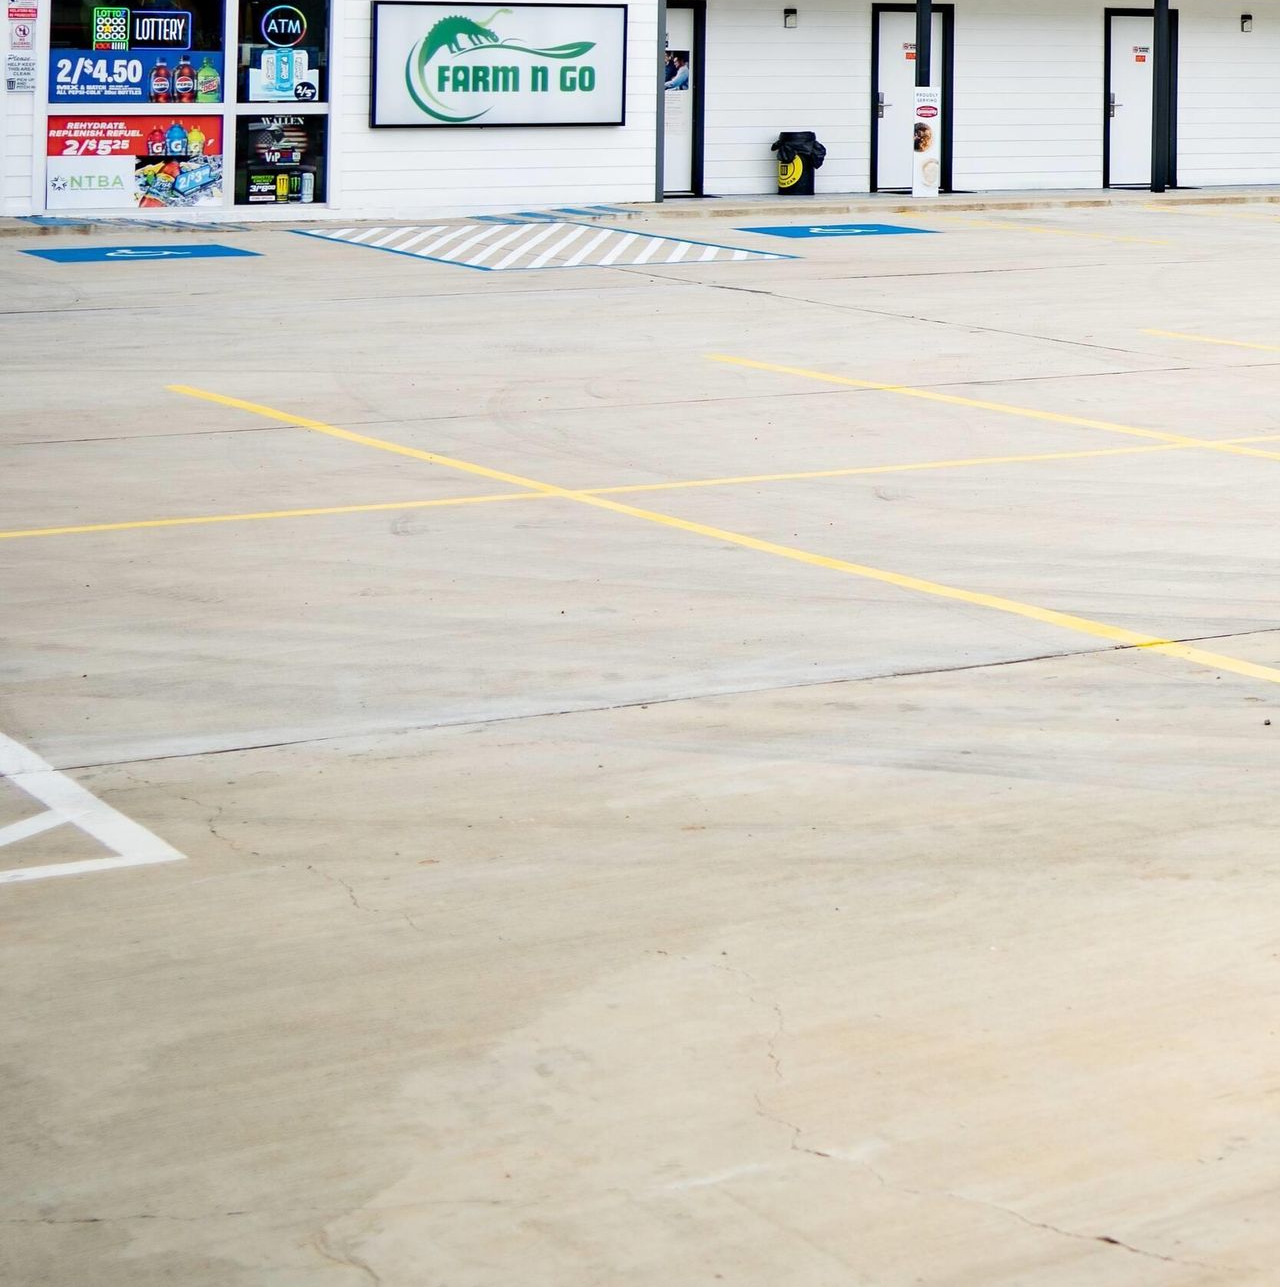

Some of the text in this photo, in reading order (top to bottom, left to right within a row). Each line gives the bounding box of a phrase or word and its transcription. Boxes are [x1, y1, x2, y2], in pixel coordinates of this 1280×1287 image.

[136, 18, 185, 41] LOTTERY
[267, 19, 301, 34] ATM
[56, 58, 143, 84] 2/$4.50
[437, 66, 520, 92] FARM
[559, 66, 596, 92] GO
[261, 117, 305, 125] WALLEN
[70, 175, 124, 188] NTBA
